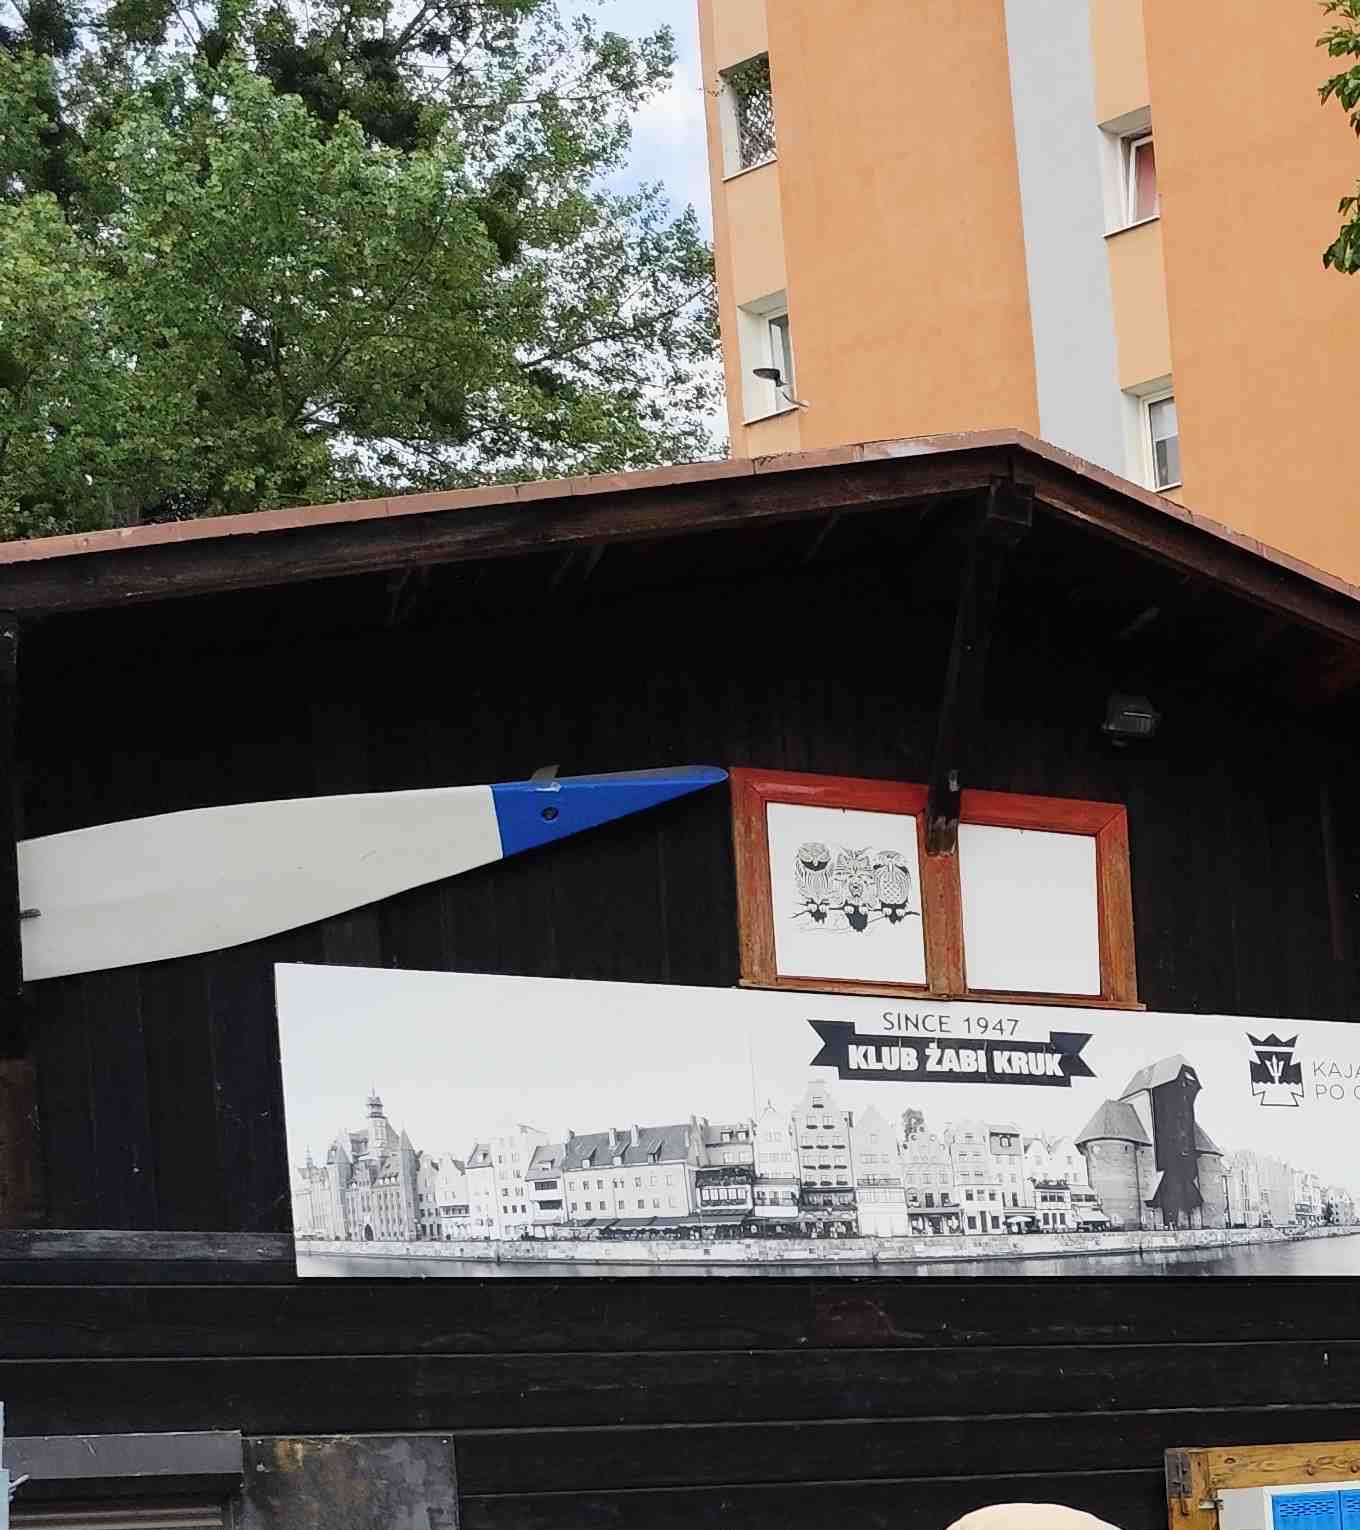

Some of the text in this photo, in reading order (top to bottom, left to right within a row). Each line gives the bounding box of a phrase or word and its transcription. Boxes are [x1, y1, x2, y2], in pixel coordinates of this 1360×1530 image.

[883, 1012, 1020, 1036] SINCE 1947
[848, 1041, 1064, 1077] KLUB ŻABI KRUK
[1315, 1084, 1345, 1101] PO
